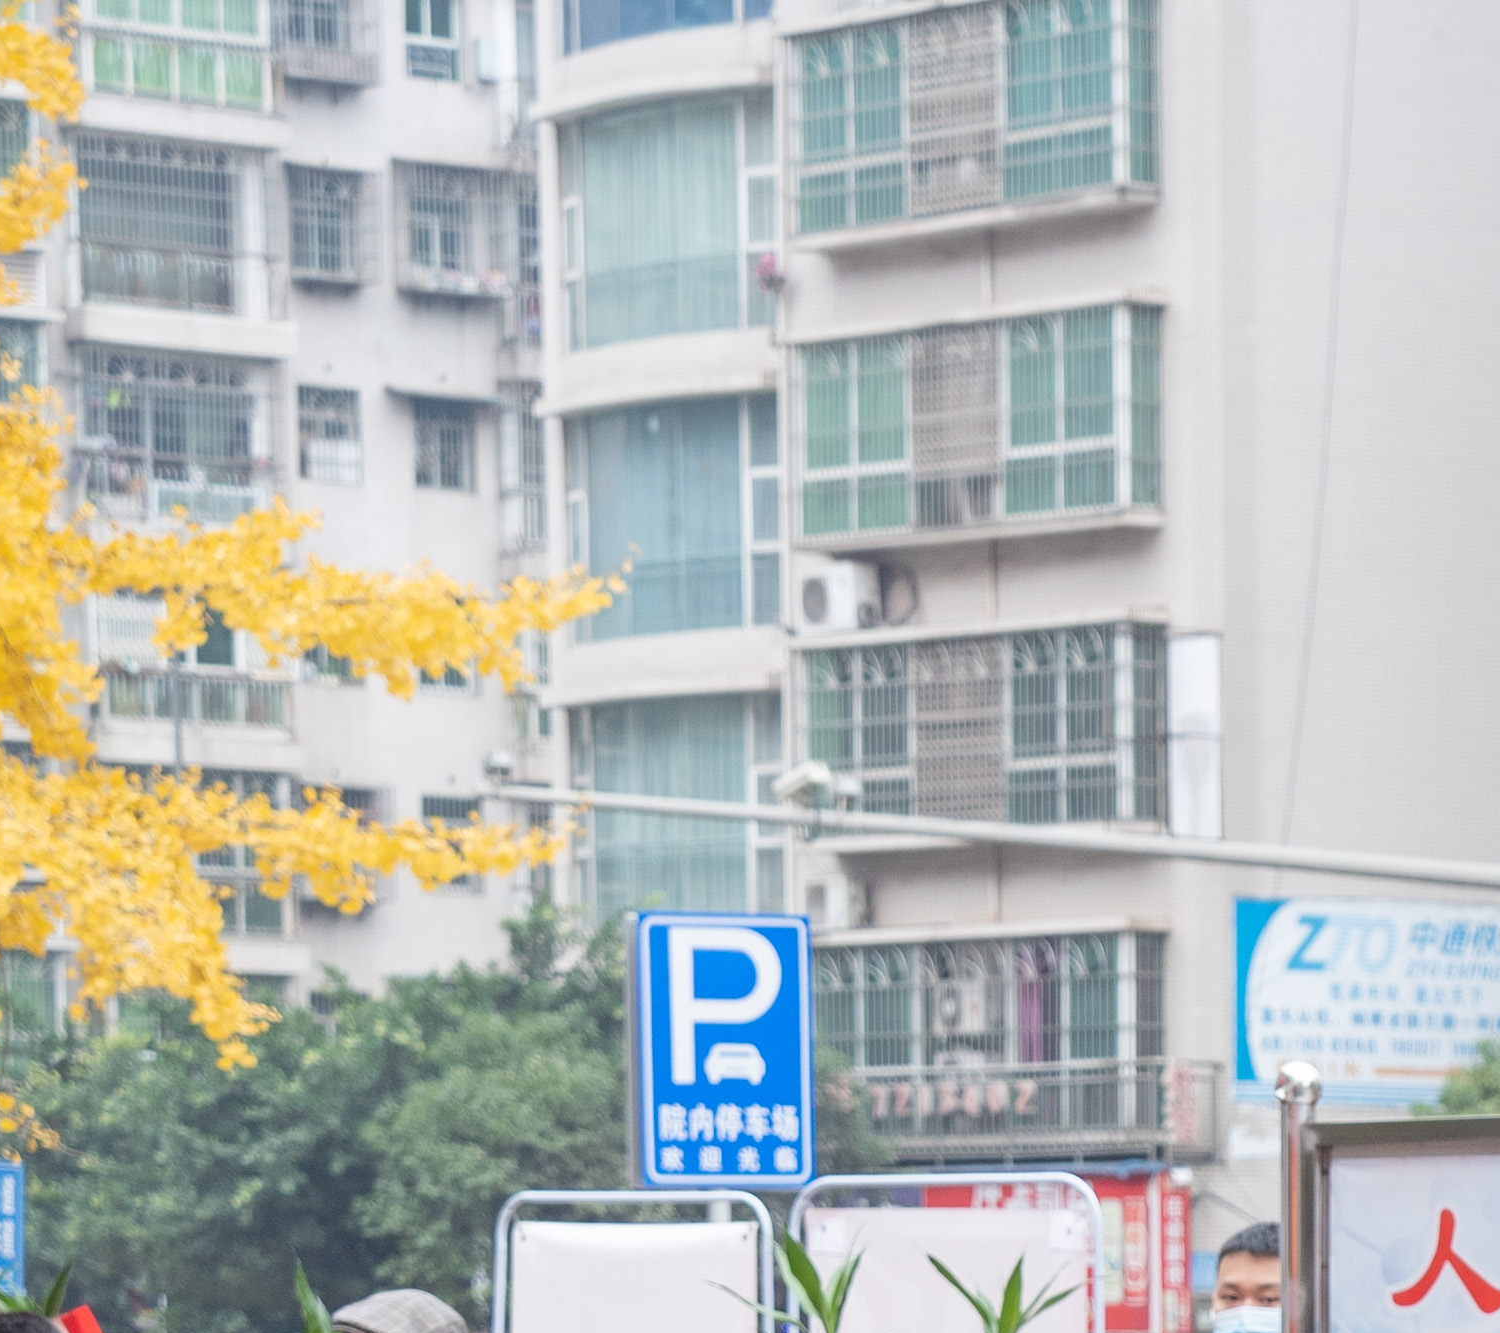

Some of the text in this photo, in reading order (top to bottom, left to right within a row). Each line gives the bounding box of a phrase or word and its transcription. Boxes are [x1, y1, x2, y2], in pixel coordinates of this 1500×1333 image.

[1287, 915, 1395, 972] ZTO
[666, 926, 783, 1086] P
[657, 1103, 800, 1142] 院内停车场
[659, 1145, 799, 1172] 欢迎光临
